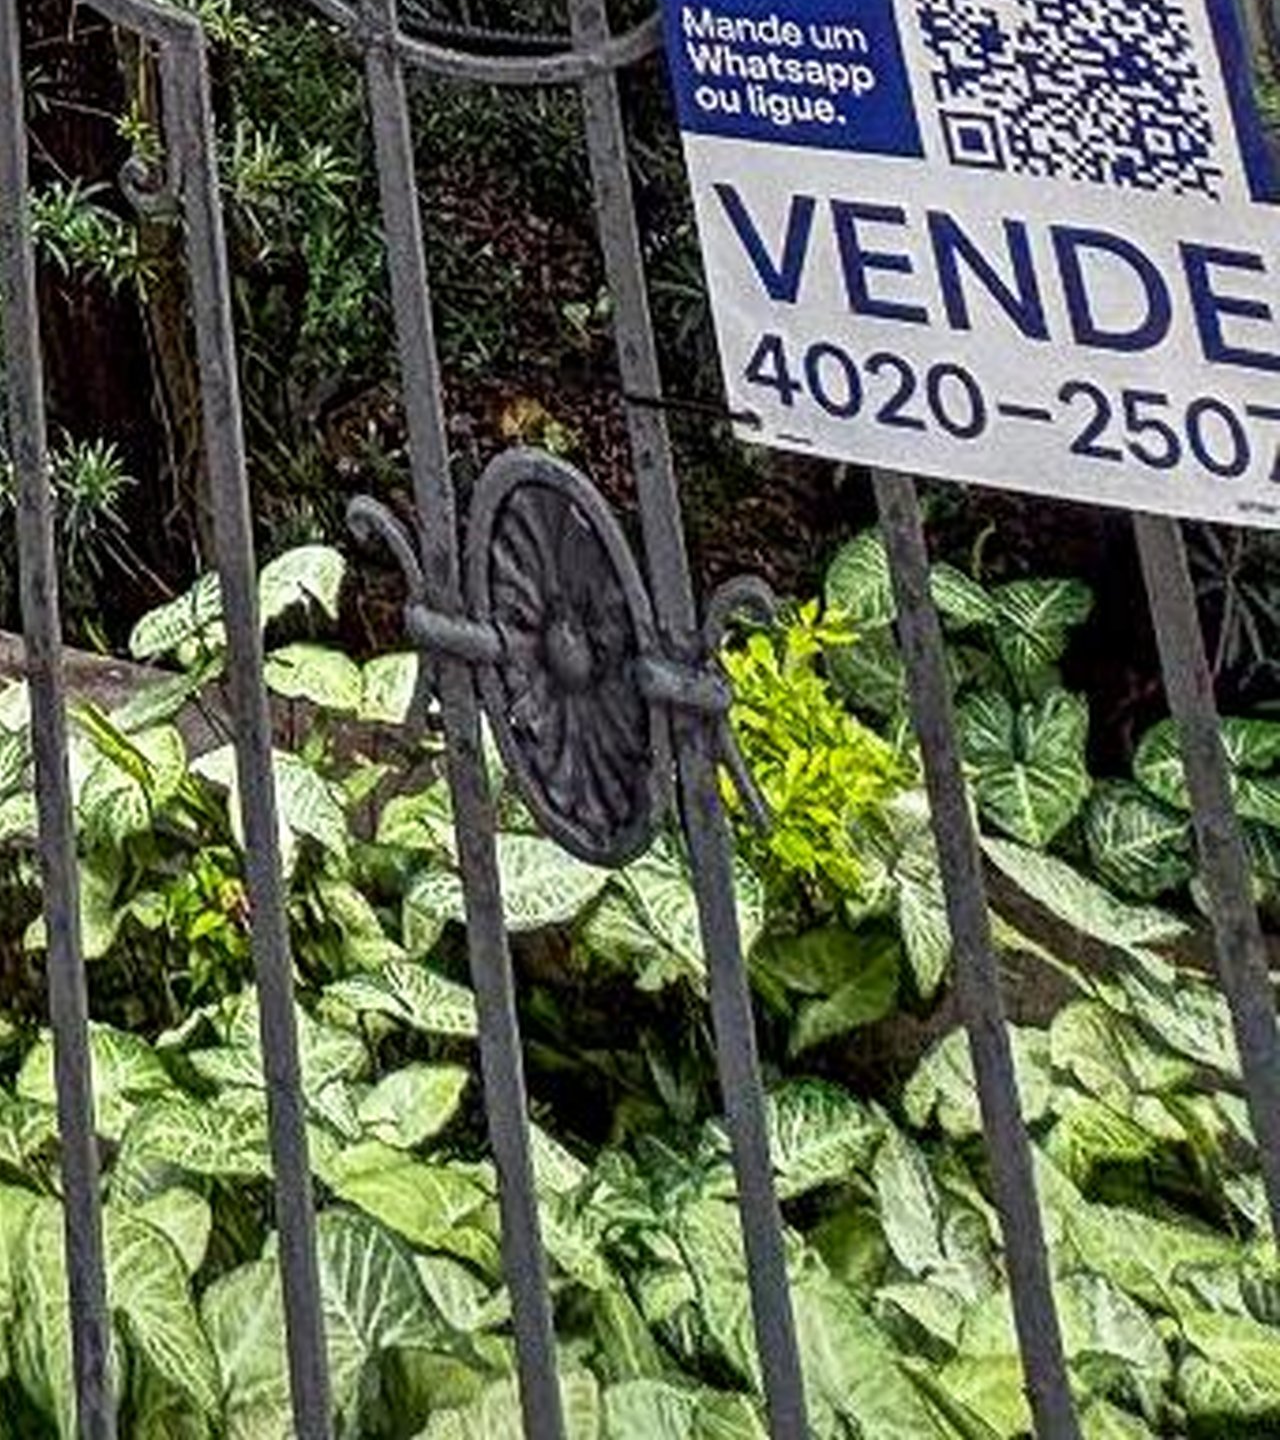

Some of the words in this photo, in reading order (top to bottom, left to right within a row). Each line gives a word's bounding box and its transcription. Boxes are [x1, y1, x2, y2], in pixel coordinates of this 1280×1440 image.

[682, 6, 803, 48] Mande
[809, 24, 868, 53] um
[686, 40, 875, 97] Whatsapp
[695, 85, 740, 114] ou
[747, 82, 847, 126] ligue.
[713, 182, 1280, 372] VENDE
